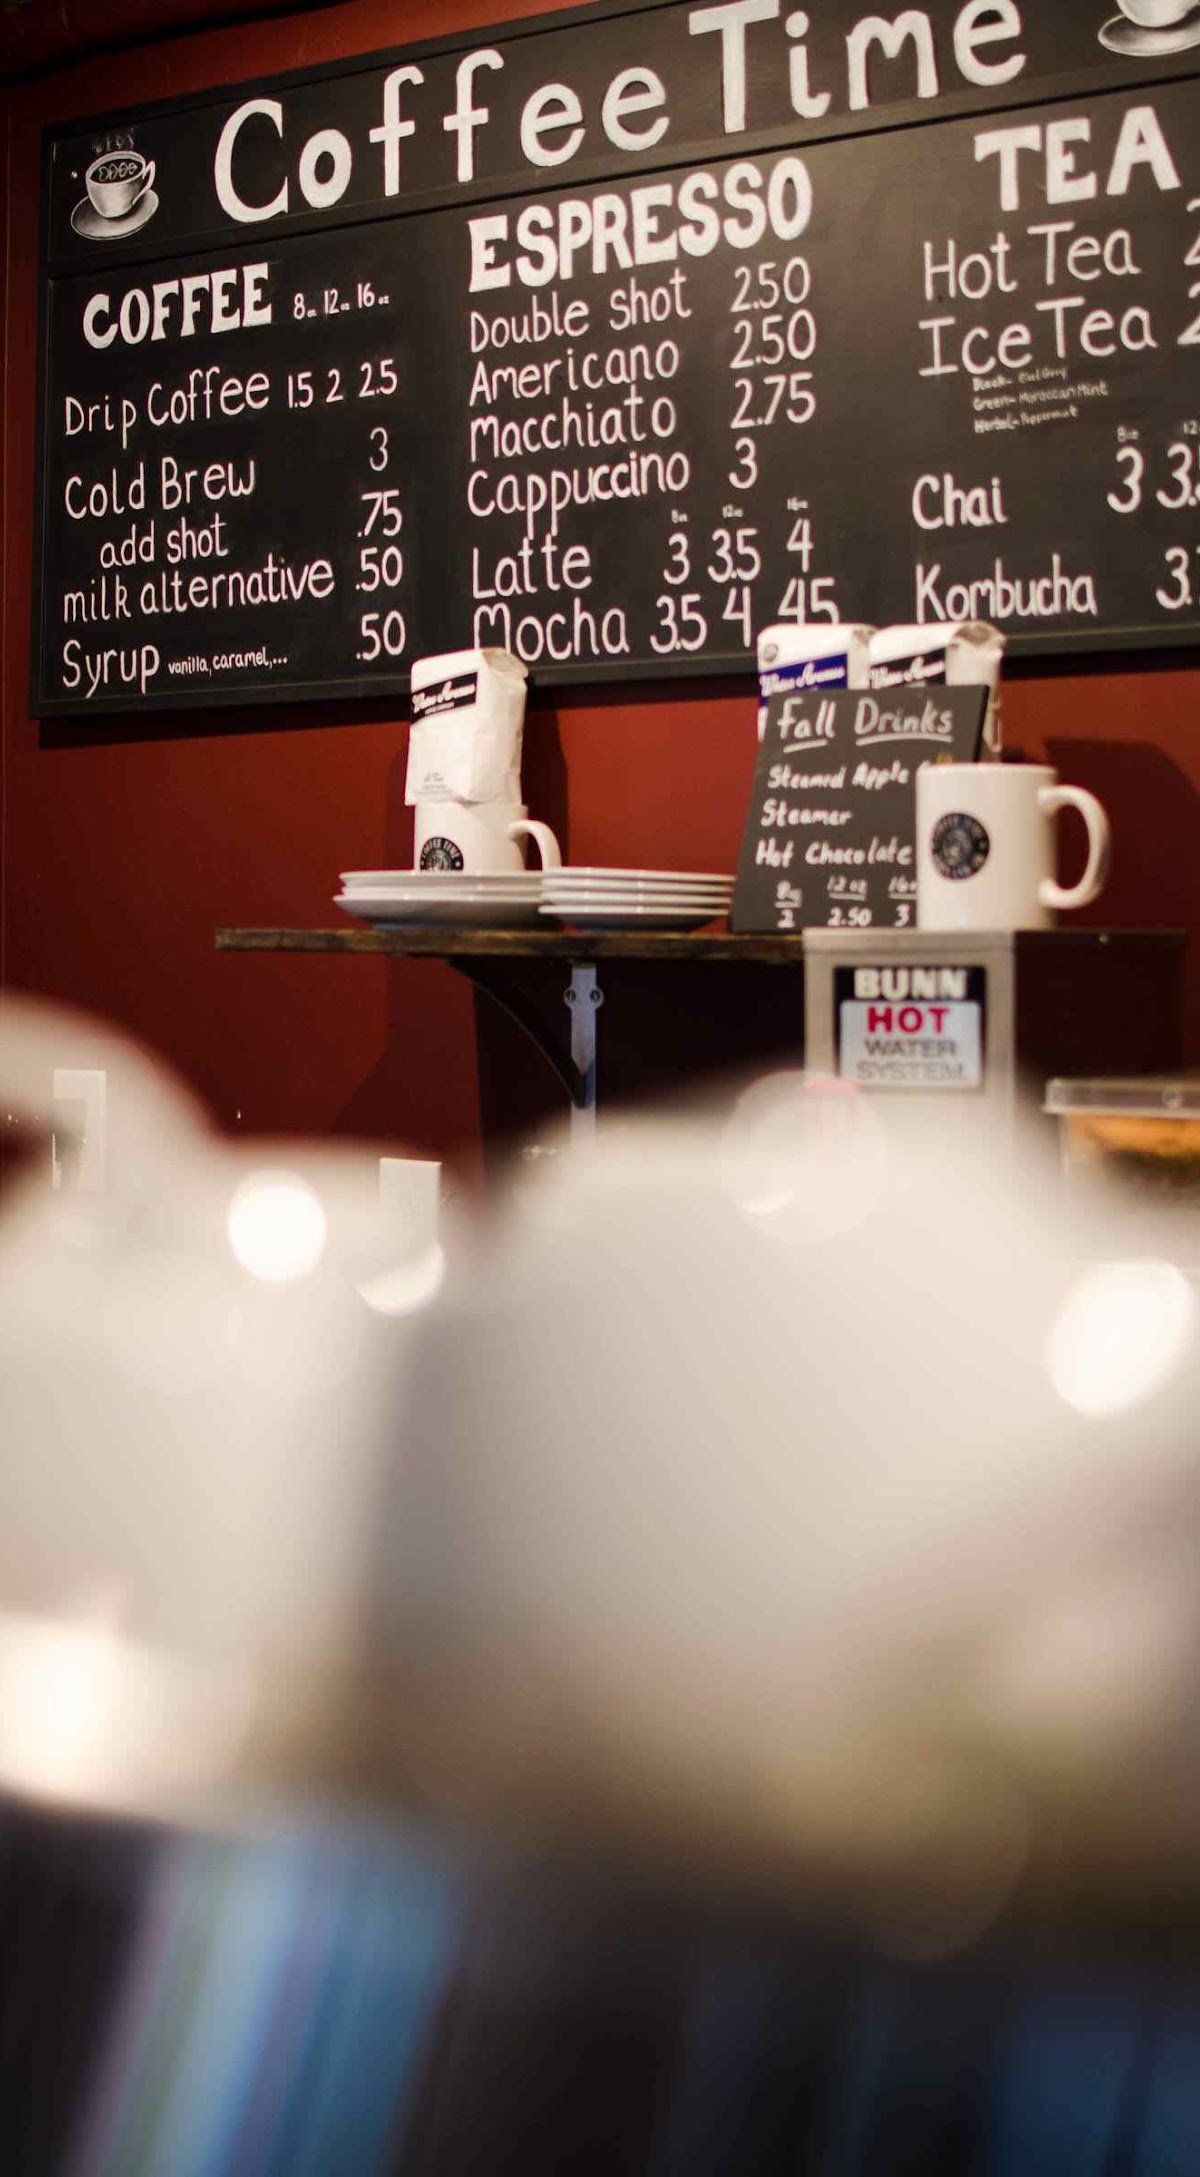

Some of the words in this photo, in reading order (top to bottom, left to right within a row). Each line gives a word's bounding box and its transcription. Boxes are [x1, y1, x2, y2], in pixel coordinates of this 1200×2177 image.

[214, 48, 671, 227] Coffee
[688, 0, 1031, 137] Time
[973, 106, 1181, 212] TEA
[465, 154, 813, 295] ESPRESSO
[923, 232, 1018, 301] Hot
[1024, 218, 1143, 286] Tea
[82, 262, 272, 349] COFFEE
[468, 289, 590, 355] Double
[609, 263, 692, 331] shot
[730, 256, 811, 316] 2.50
[918, 316, 1035, 379] Ice
[1034, 294, 1160, 360] Tea
[469, 337, 680, 409] Americano
[729, 307, 817, 369] 2.50
[65, 395, 137, 450] Drip
[147, 366, 270, 427] Coffee
[288, 371, 314, 409] 1.5
[325, 368, 344, 403] 2
[358, 358, 398, 398] 2.5
[469, 381, 681, 465] Macchiato
[730, 371, 816, 429] 2.75
[1183, 420, 1200, 435] 12
[65, 461, 145, 520] Cold
[161, 456, 255, 510] Brew
[369, 427, 388, 472] 3
[467, 449, 690, 541] Cappuccino
[728, 437, 758, 489] 3
[912, 473, 1007, 530] Chai
[1107, 446, 1144, 514] 3
[1156, 442, 1200, 509] 3.
[100, 520, 155, 569] add
[166, 512, 229, 564] shot
[357, 489, 403, 538] .75
[472, 531, 592, 601] Latte
[663, 532, 690, 585] 3
[707, 528, 761, 583] 3.5
[786, 518, 813, 573] 4
[62, 578, 134, 626] milk
[139, 551, 335, 615] alternative
[355, 545, 403, 592] .50
[473, 597, 631, 662] Mocha
[722, 586, 752, 648] 4
[913, 553, 1098, 627] Kombucha
[62, 638, 162, 700] Syrup
[167, 656, 214, 680] vanilla,
[356, 610, 406, 661] .50
[776, 697, 836, 739] Fall
[854, 697, 952, 736] Drinks
[760, 798, 851, 827] Steamer
[851, 761, 909, 790] Apple
[755, 837, 794, 868] Hot
[805, 837, 912, 865] Chocolate
[777, 908, 795, 929] 2
[827, 907, 872, 927] 2.50
[894, 903, 910, 930] 3
[853, 967, 968, 1001] BUNN
[866, 1005, 951, 1035] HOT
[854, 1060, 966, 1082] SYSTEM
[863, 1038, 959, 1058] WATER
